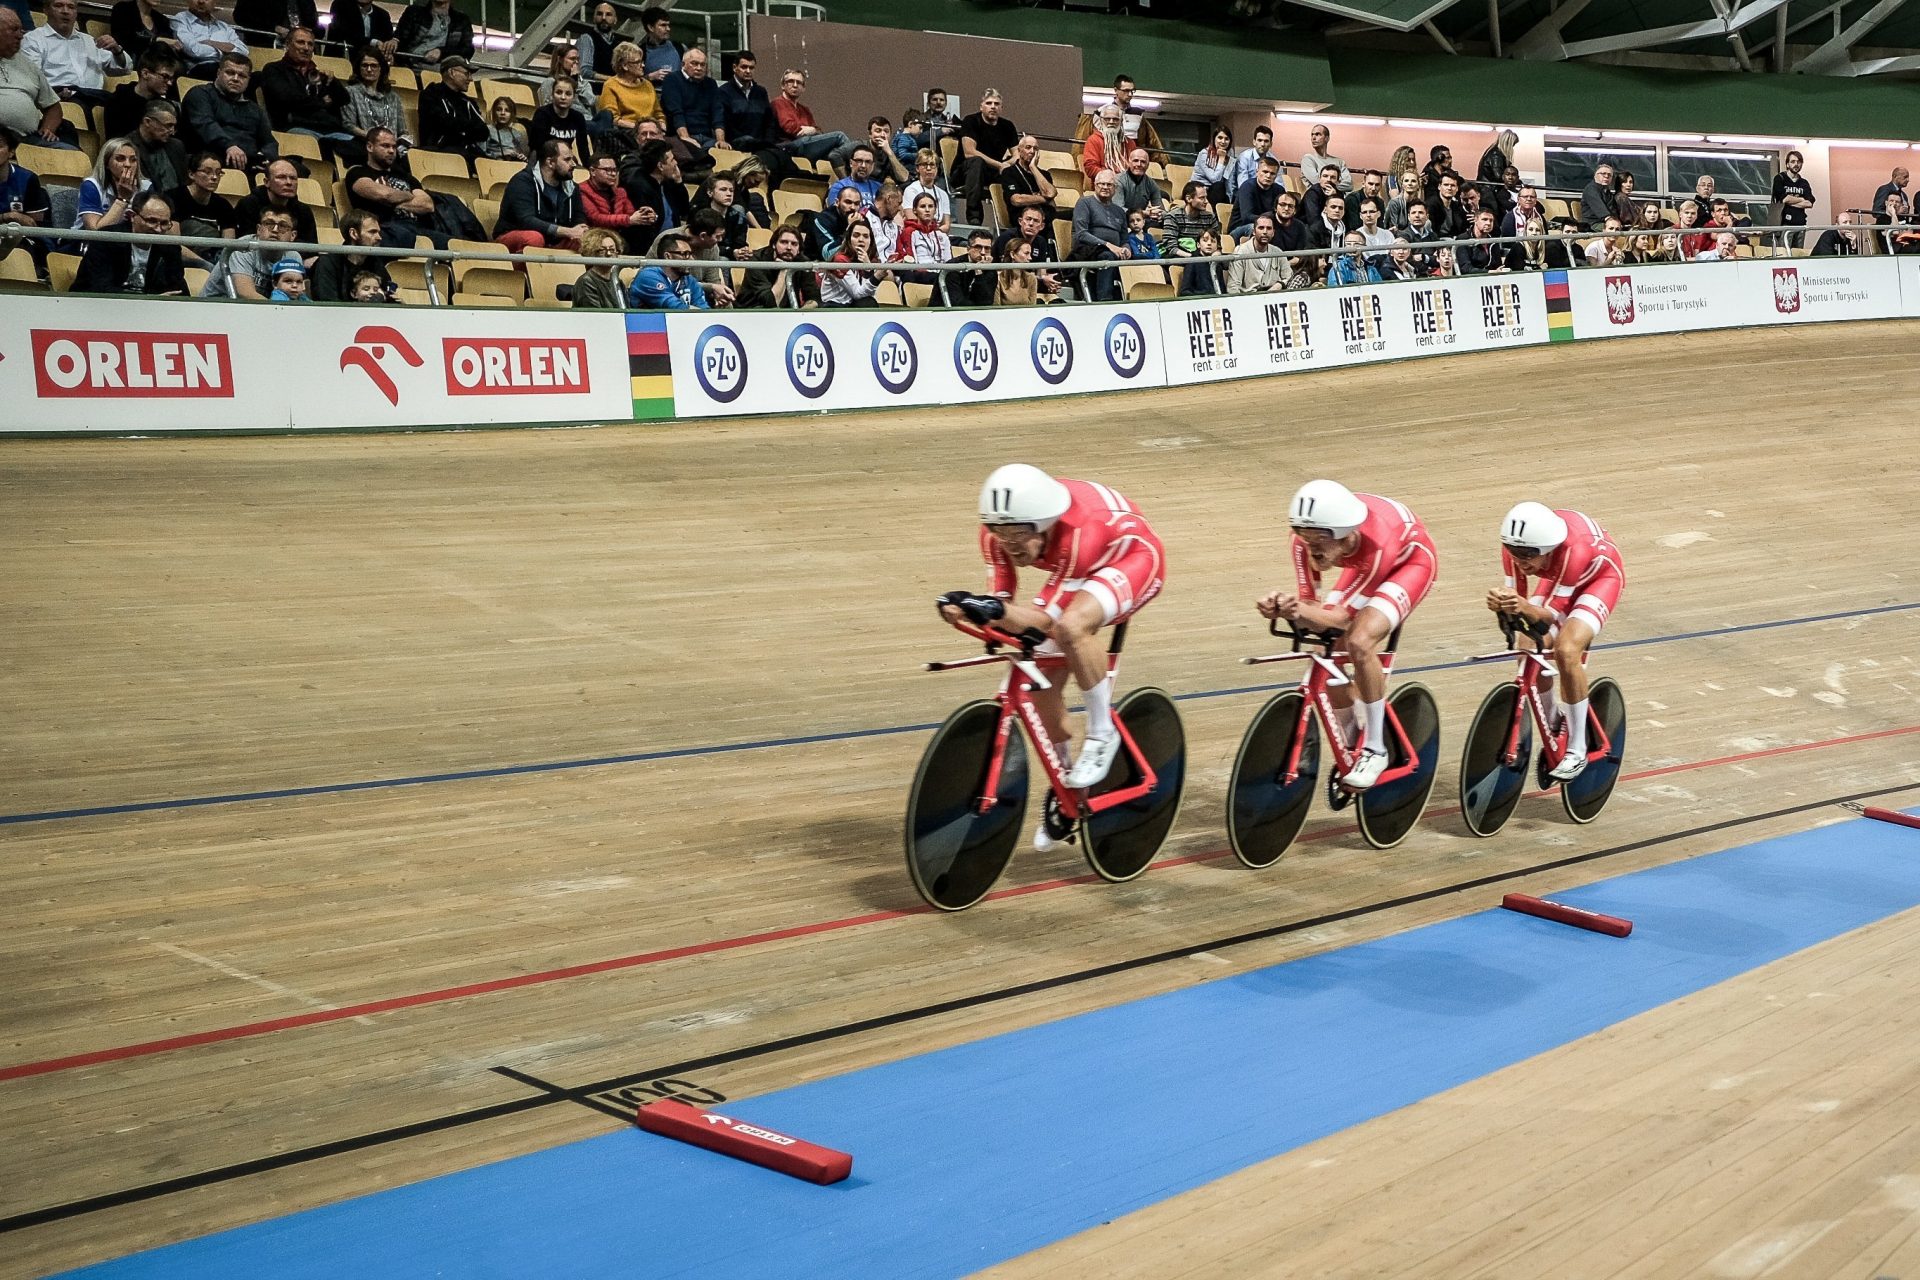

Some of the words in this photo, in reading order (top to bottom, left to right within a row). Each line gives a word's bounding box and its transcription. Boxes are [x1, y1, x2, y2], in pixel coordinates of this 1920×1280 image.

[1636, 284, 1688, 295] Ministerstwo
[1802, 276, 1851, 286] Ministerstwo
[1339, 294, 1382, 320] INTER
[1410, 288, 1452, 313] INTER
[1480, 283, 1520, 307] INTER
[1638, 302, 1665, 315] Sportu
[1672, 298, 1708, 311] Turystyki
[1803, 292, 1829, 305] Sportu
[1835, 290, 1869, 303] Turystyki
[1186, 308, 1233, 335] INTER
[1264, 301, 1309, 327] INTER
[1413, 310, 1453, 335] FLEET
[1483, 304, 1521, 328] FLEET
[1267, 323, 1310, 351] FLEET
[1342, 316, 1383, 342] FLEET
[1415, 335, 1434, 347] rent
[1436, 335, 1442, 345] a
[1443, 333, 1457, 344] car
[1485, 328, 1503, 340] rent
[1505, 328, 1510, 338] a
[1511, 326, 1525, 337] car
[963, 342, 988, 371] PZU
[1040, 337, 1064, 365] PZU
[1113, 333, 1137, 360] PZU
[1190, 331, 1234, 359] FLEET
[1270, 351, 1290, 364] rent
[1292, 352, 1298, 362] a
[1299, 349, 1314, 360] car
[1345, 342, 1364, 355] rent
[1365, 343, 1371, 353] a
[1372, 340, 1386, 352] car
[44, 339, 222, 389] ORLEN
[452, 345, 581, 388] ORLEN
[707, 348, 737, 380] PZU
[796, 346, 824, 377] PZU
[881, 344, 908, 373] PZU
[1192, 360, 1213, 373] rent
[1215, 359, 1222, 370] a
[1223, 357, 1238, 369] car
[991, 488, 1011, 513] 11
[1298, 497, 1315, 517] 11
[1510, 519, 1526, 537] 11
